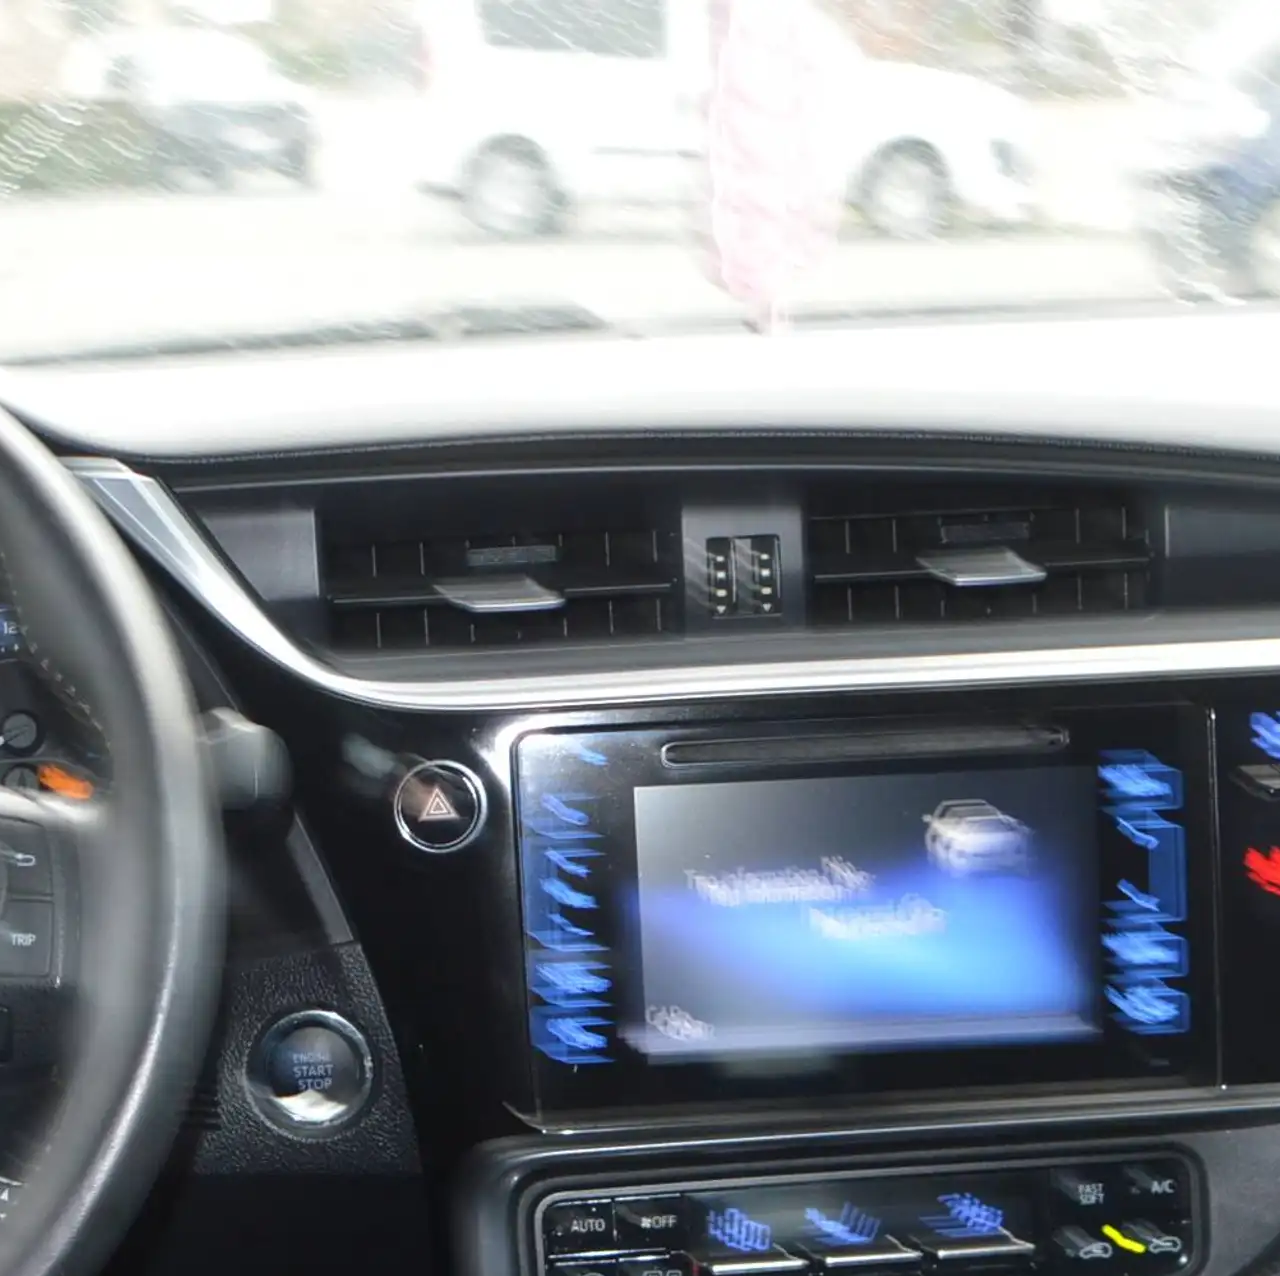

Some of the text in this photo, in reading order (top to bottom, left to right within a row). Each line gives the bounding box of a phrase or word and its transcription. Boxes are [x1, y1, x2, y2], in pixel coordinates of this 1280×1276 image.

[3, 621, 18, 635] 12
[11, 932, 37, 947] TRIP
[292, 1064, 334, 1078] START
[297, 1077, 333, 1090] STOP
[1150, 1179, 1176, 1194] A/C
[570, 1218, 607, 1233] AUTO
[651, 1215, 678, 1230] OFF
